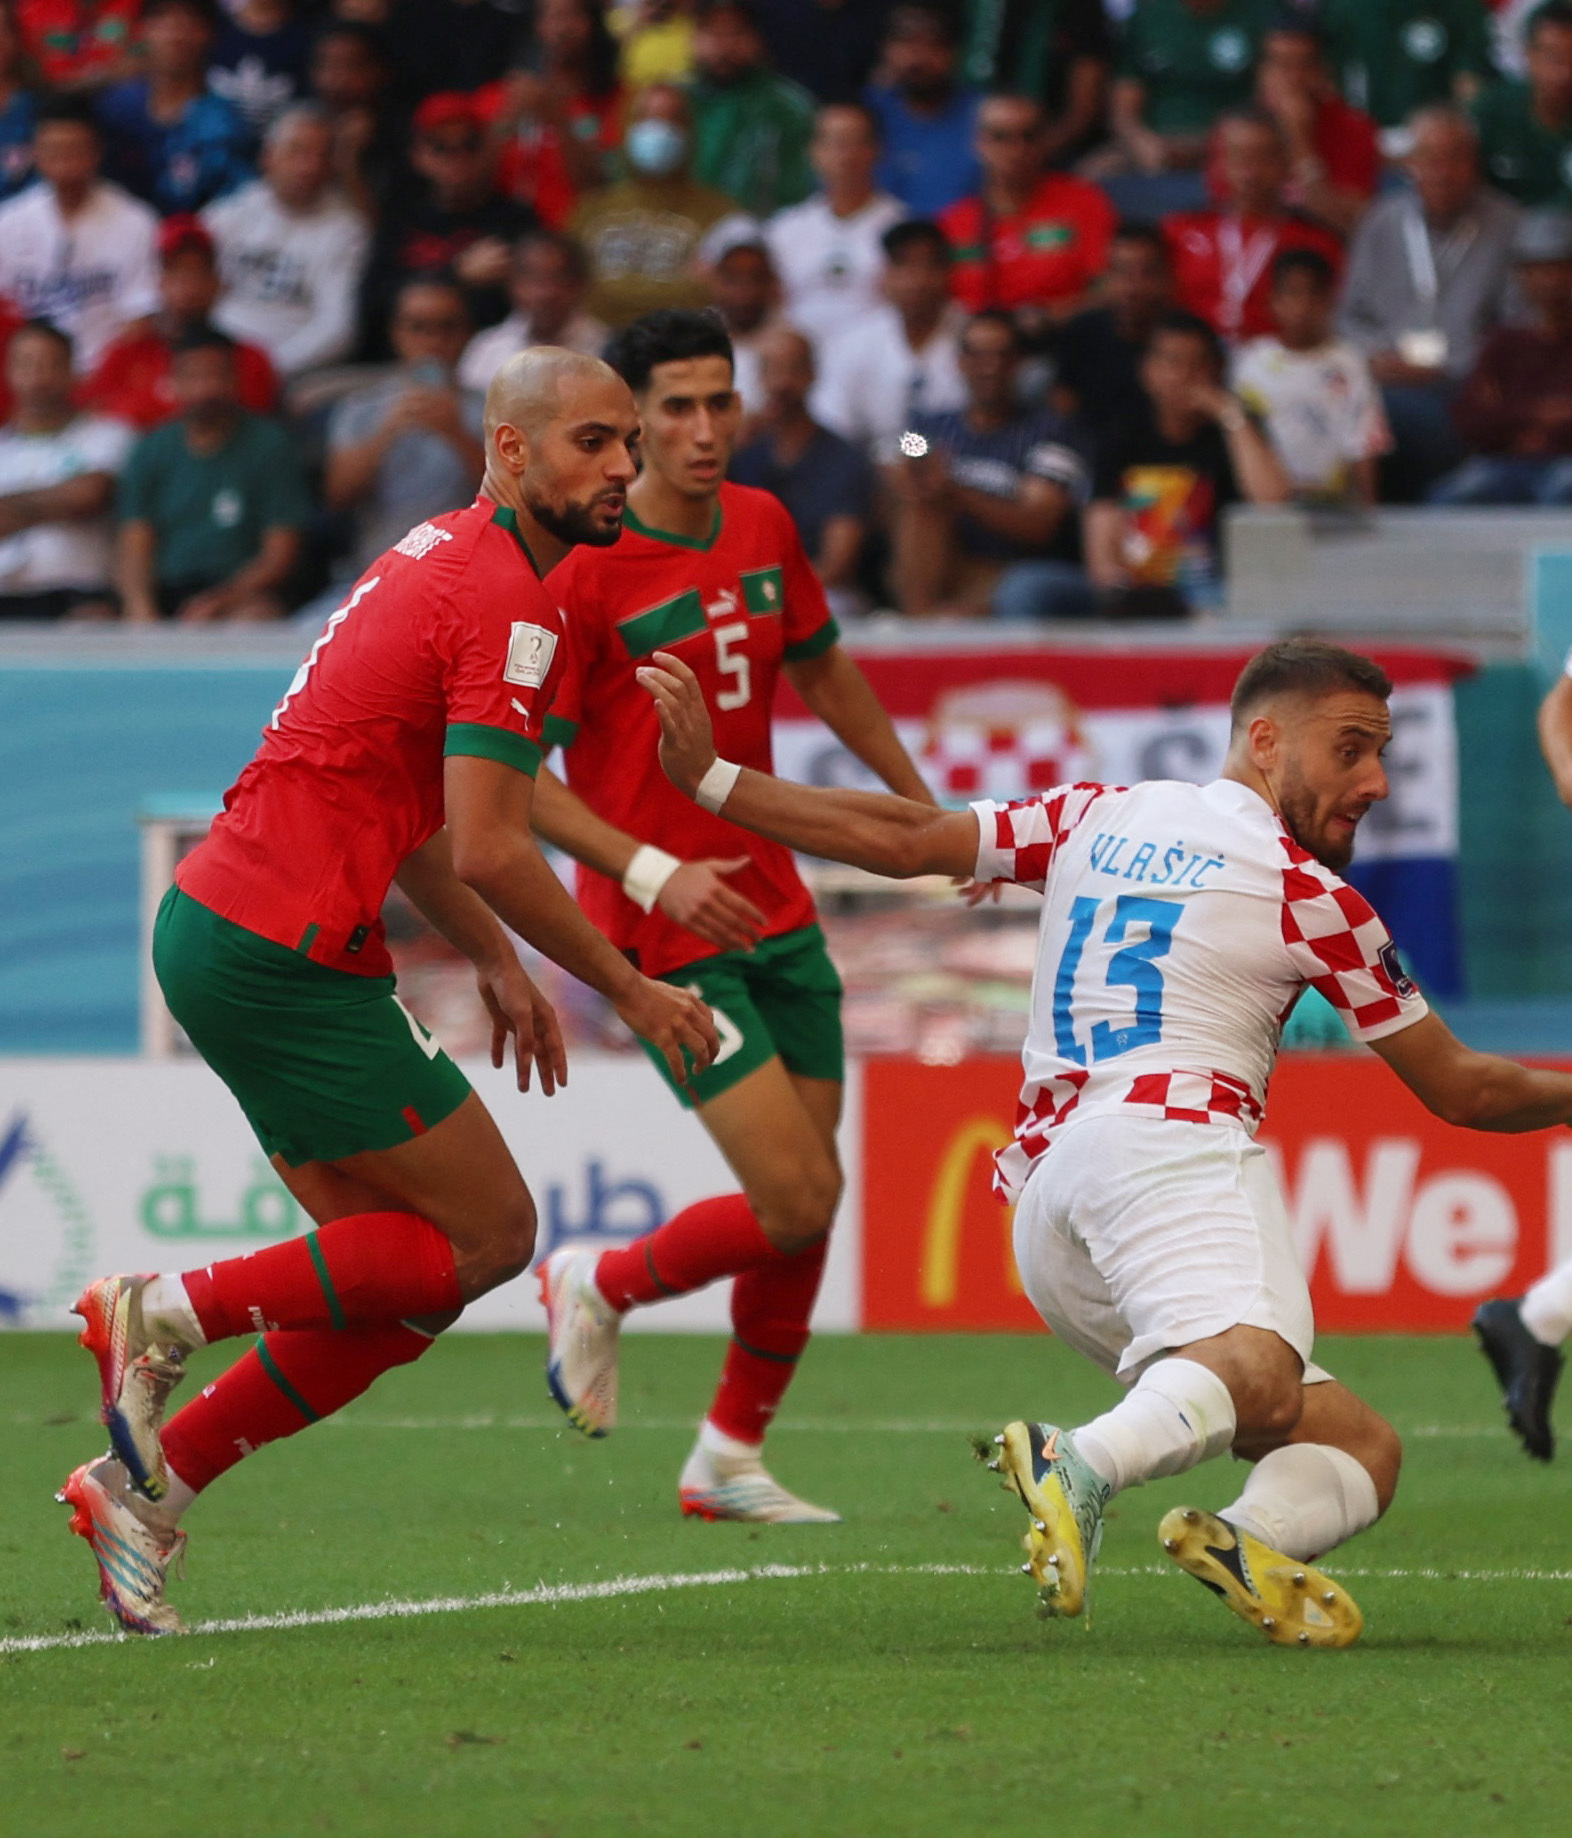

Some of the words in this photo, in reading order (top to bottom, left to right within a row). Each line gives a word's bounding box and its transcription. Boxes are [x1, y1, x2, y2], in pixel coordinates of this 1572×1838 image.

[713, 621, 751, 711] 5
[1053, 895, 1185, 1067] 13
[1262, 1136, 1520, 1298] We
